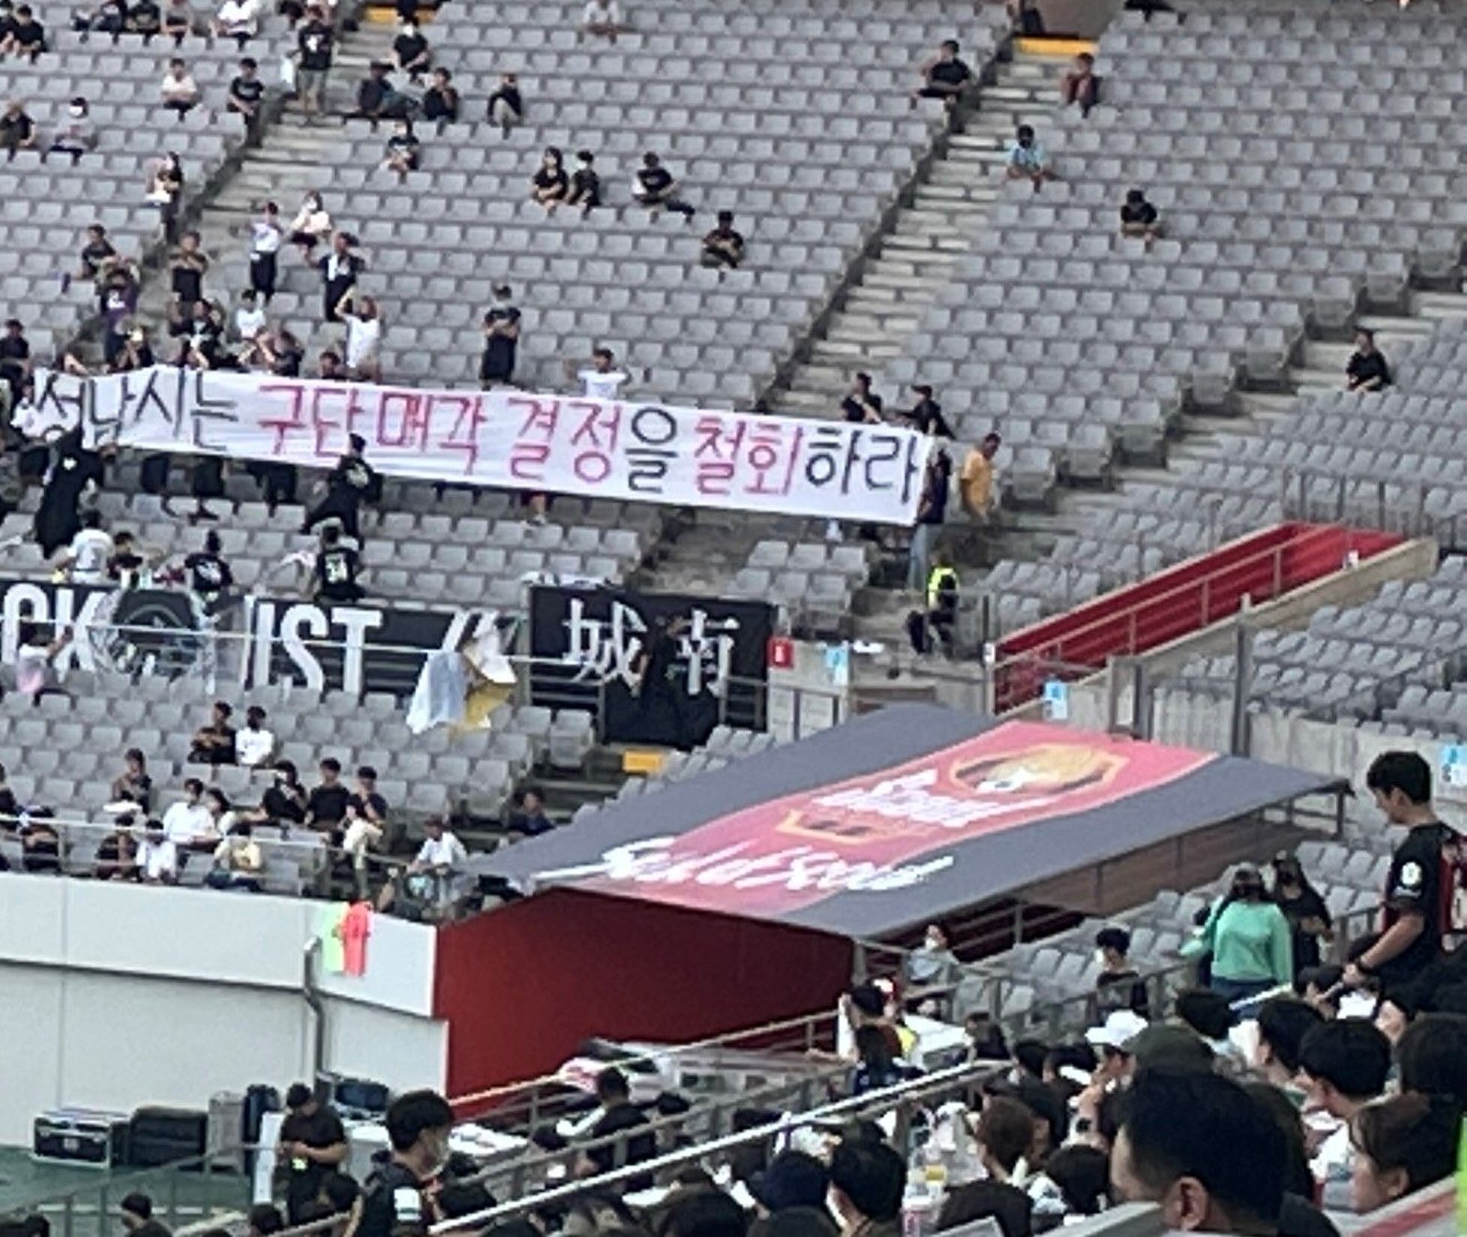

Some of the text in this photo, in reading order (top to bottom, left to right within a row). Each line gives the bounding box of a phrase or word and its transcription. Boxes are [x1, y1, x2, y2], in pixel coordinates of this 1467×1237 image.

[258, 384, 488, 477] 구단매각
[507, 397, 679, 494] 결정을
[694, 417, 920, 504] 철회하라
